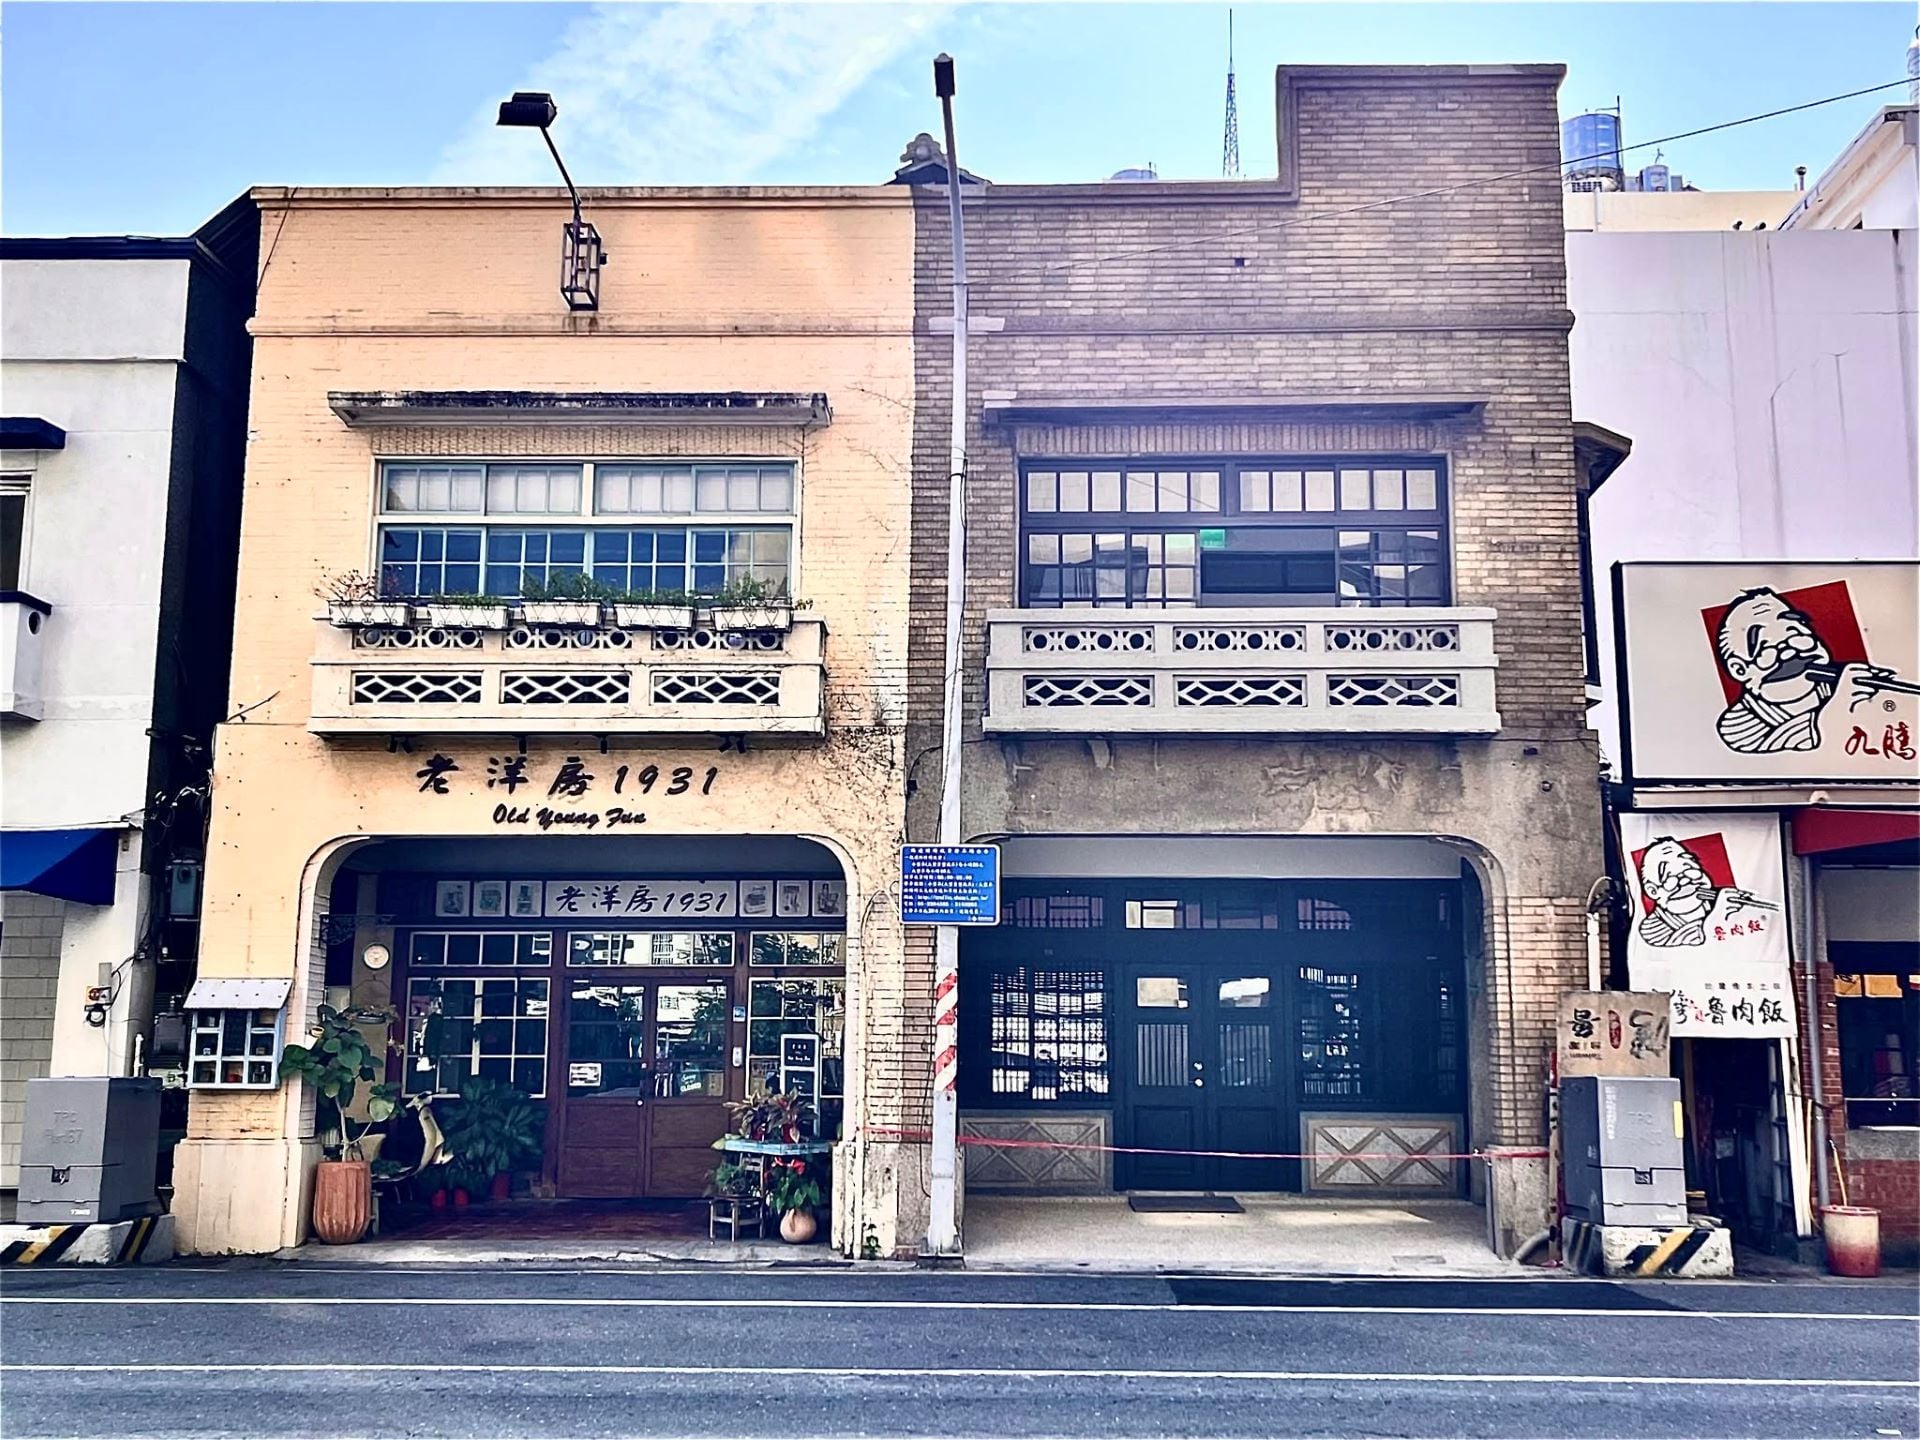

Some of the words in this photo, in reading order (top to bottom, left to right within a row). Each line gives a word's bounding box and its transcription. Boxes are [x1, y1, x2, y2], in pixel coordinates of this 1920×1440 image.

[492, 803, 530, 825] Old
[535, 808, 601, 831] Young
[605, 807, 647, 829] Fun
[555, 884, 729, 914] 老洋房1931
